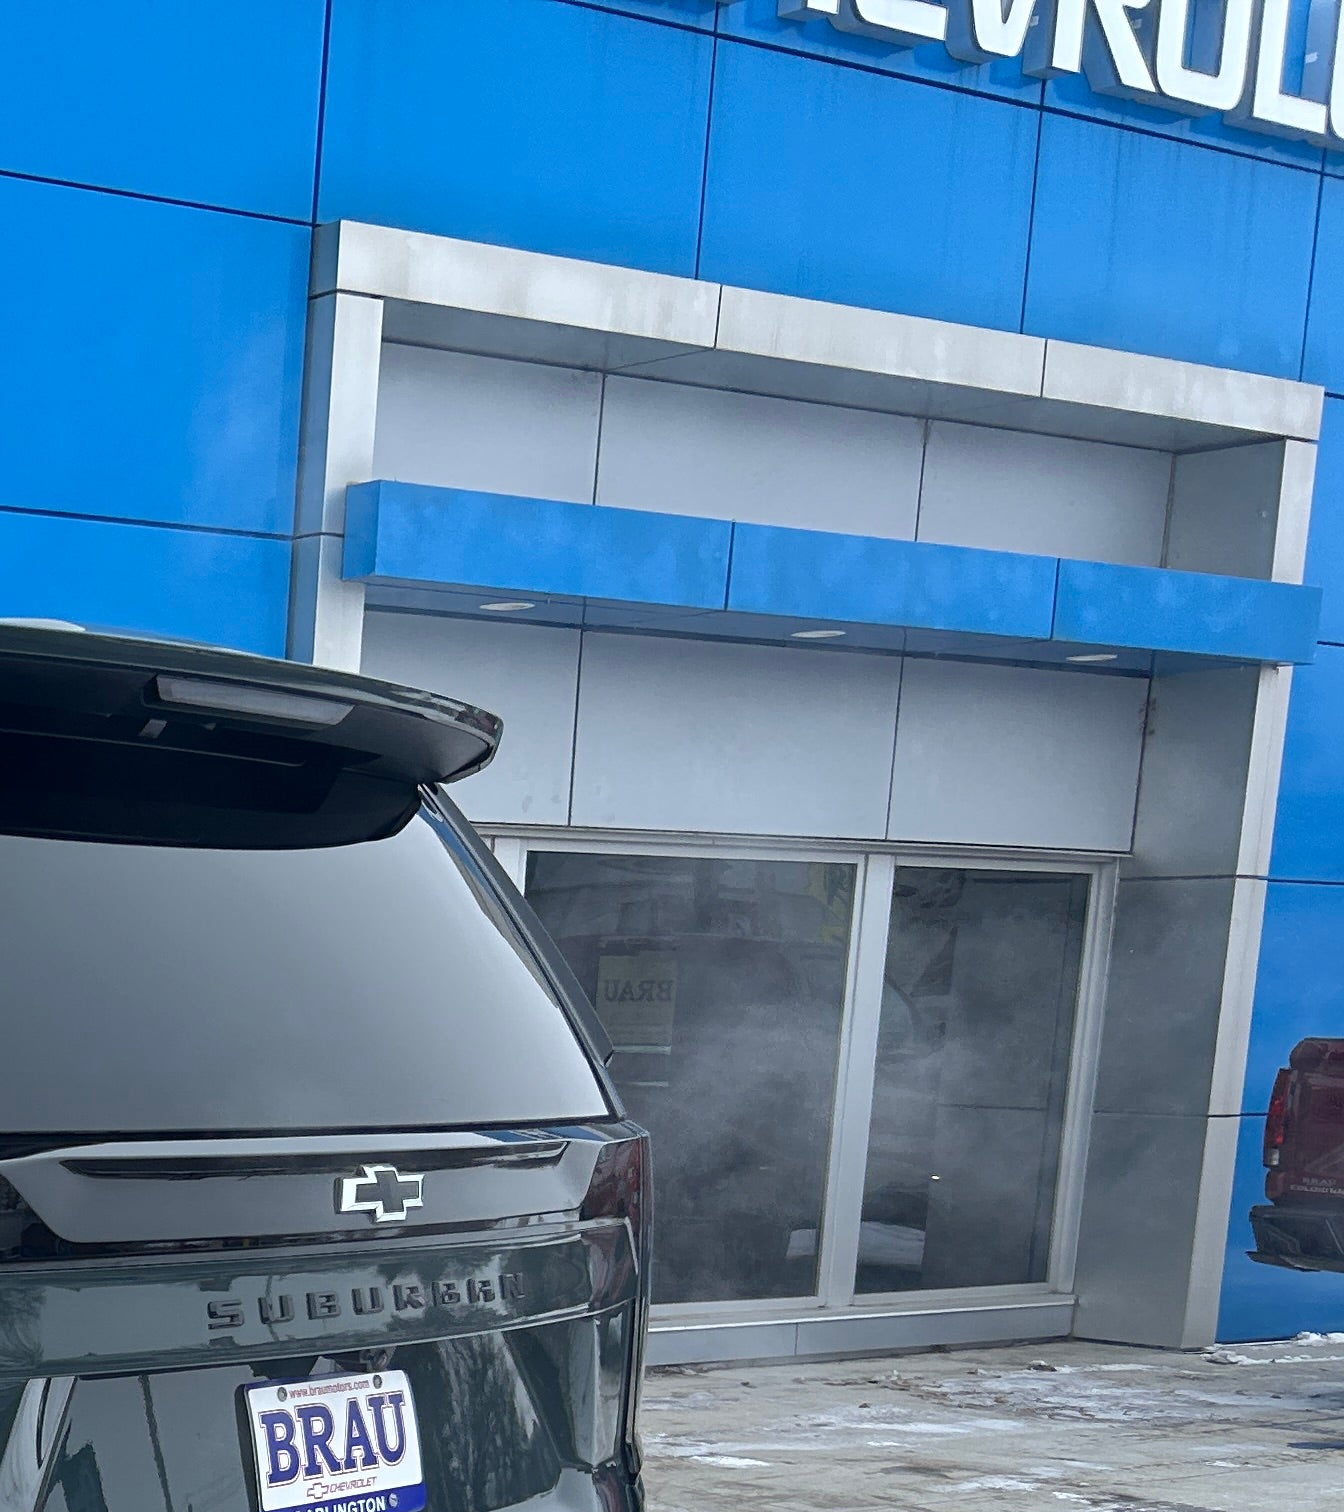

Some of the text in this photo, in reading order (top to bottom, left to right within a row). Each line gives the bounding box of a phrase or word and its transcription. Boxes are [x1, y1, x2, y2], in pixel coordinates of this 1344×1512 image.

[207, 1272, 527, 1331] SUBURBAN
[258, 1390, 406, 1489] BRAU
[329, 1476, 377, 1493] CHEVROLET
